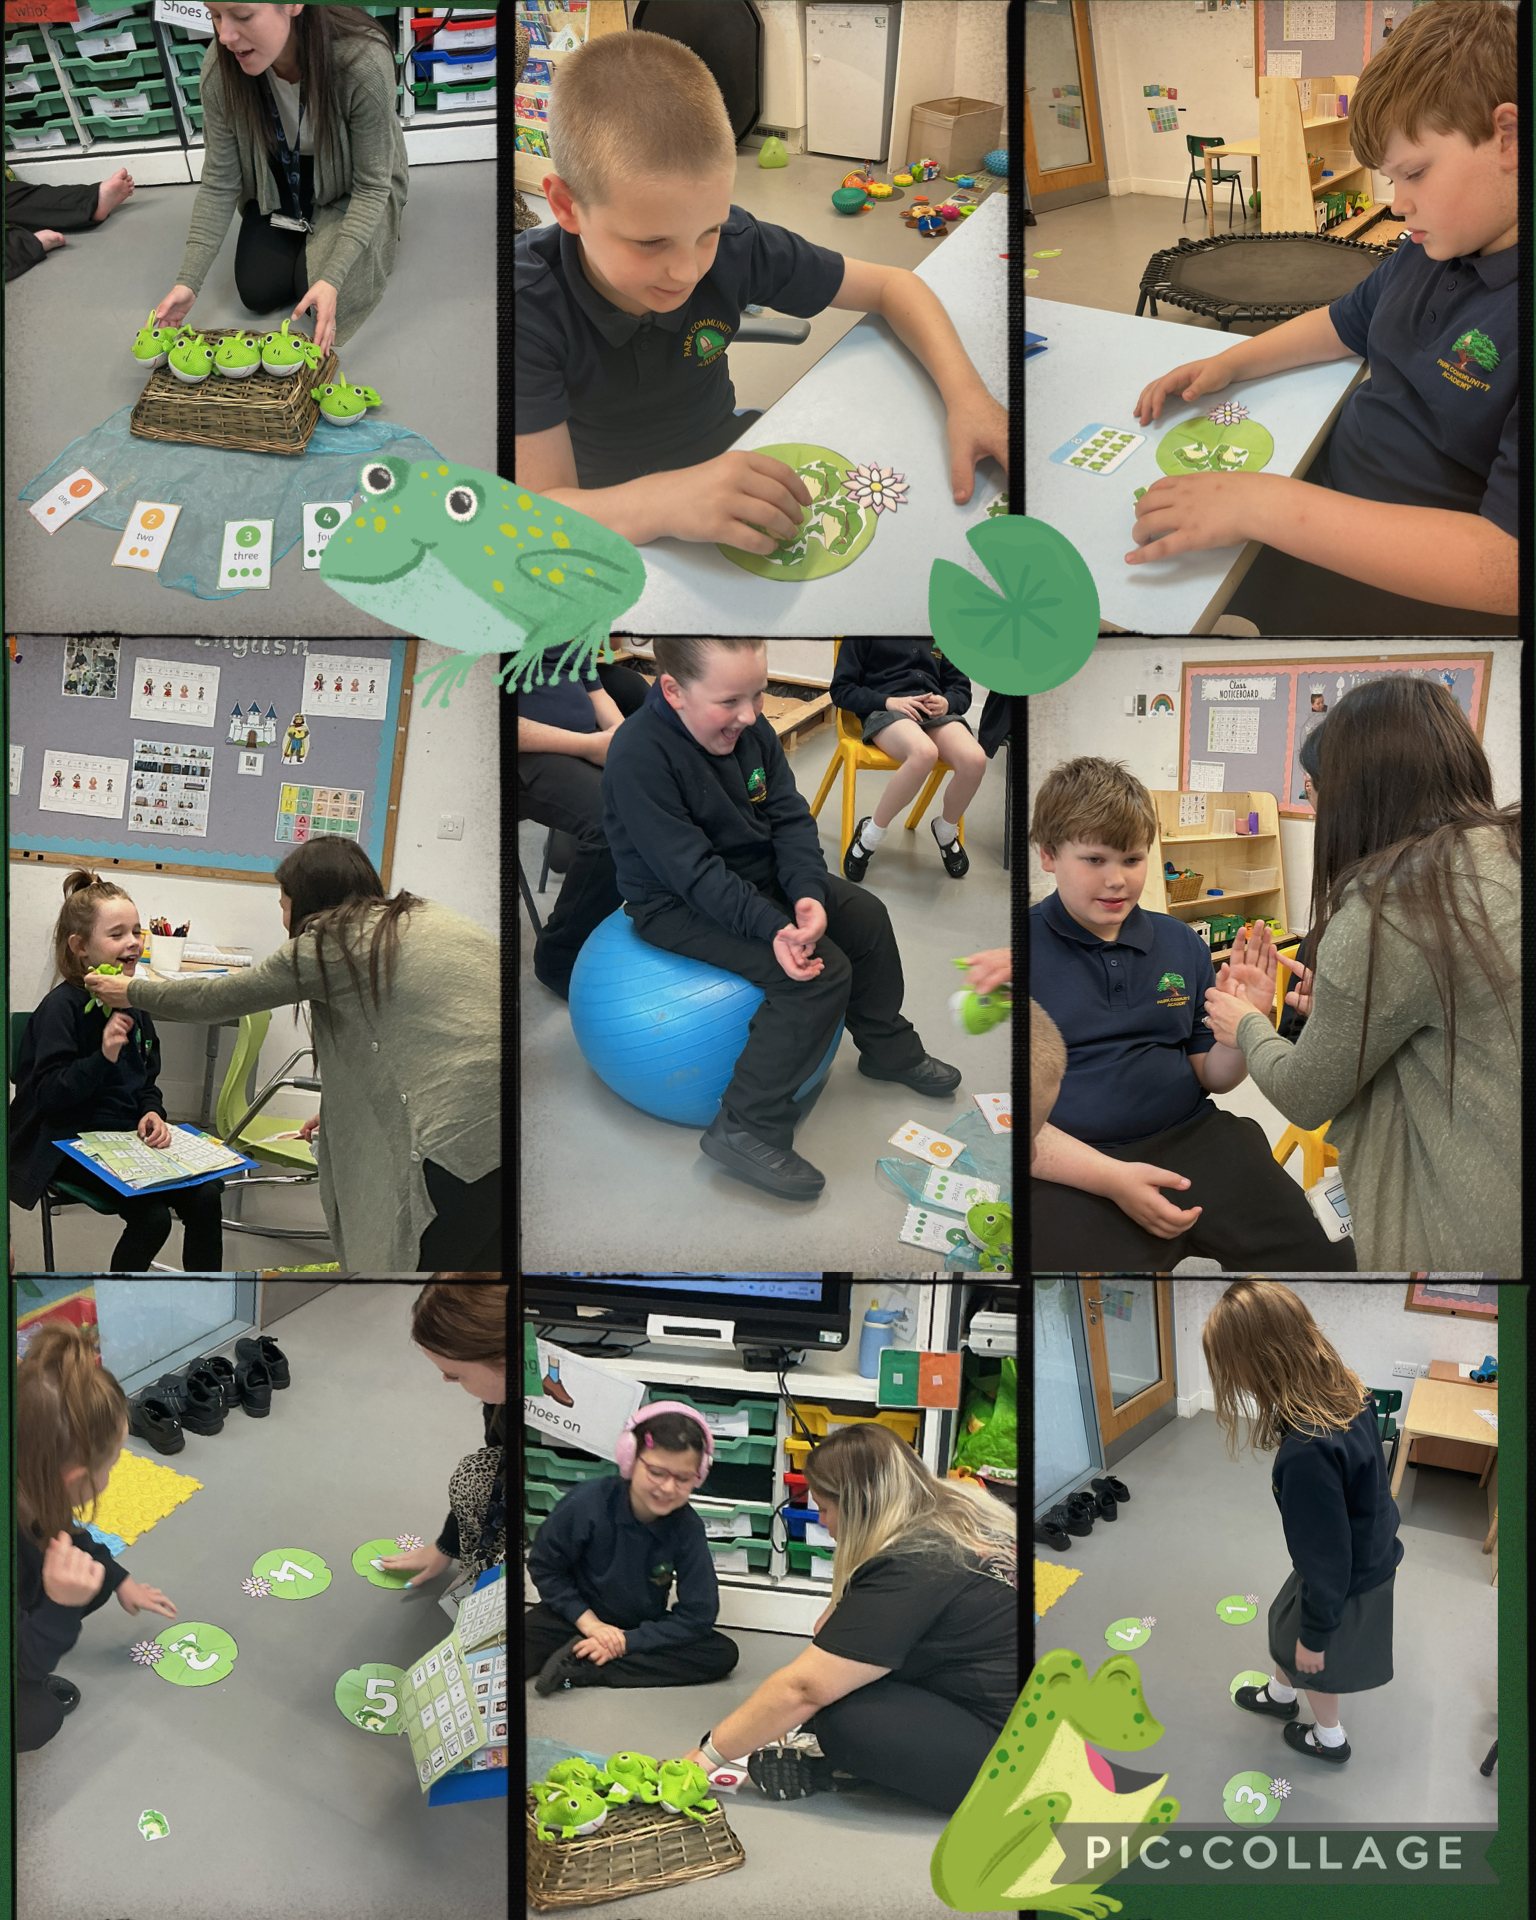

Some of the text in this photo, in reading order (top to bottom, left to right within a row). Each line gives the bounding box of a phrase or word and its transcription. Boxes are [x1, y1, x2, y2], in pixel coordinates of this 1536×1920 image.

[15, 4, 48, 18] who?
[163, 1, 213, 20] Shoes o
[683, 318, 732, 358] PARK COMMUNITY
[1436, 358, 1491, 392] PARK COMMUNITY
[1441, 370, 1472, 391] ACADEMY
[1070, 436, 1083, 445] 8
[78, 484, 87, 493] 1
[57, 493, 71, 507] one
[146, 513, 157, 525] 2
[322, 512, 332, 523] 4
[136, 532, 154, 543] two
[244, 531, 253, 542] 3
[317, 532, 332, 543] fou
[233, 550, 259, 561] three
[1229, 680, 1247, 690] Class
[1219, 689, 1259, 699] NOTICEBOARD
[523, 1398, 582, 1433] Shoes on
[269, 1560, 314, 1582] 4
[1225, 1605, 1248, 1614] 1
[1115, 1626, 1142, 1642] 4
[365, 1678, 399, 1718] 5
[1235, 1785, 1268, 1816] 3
